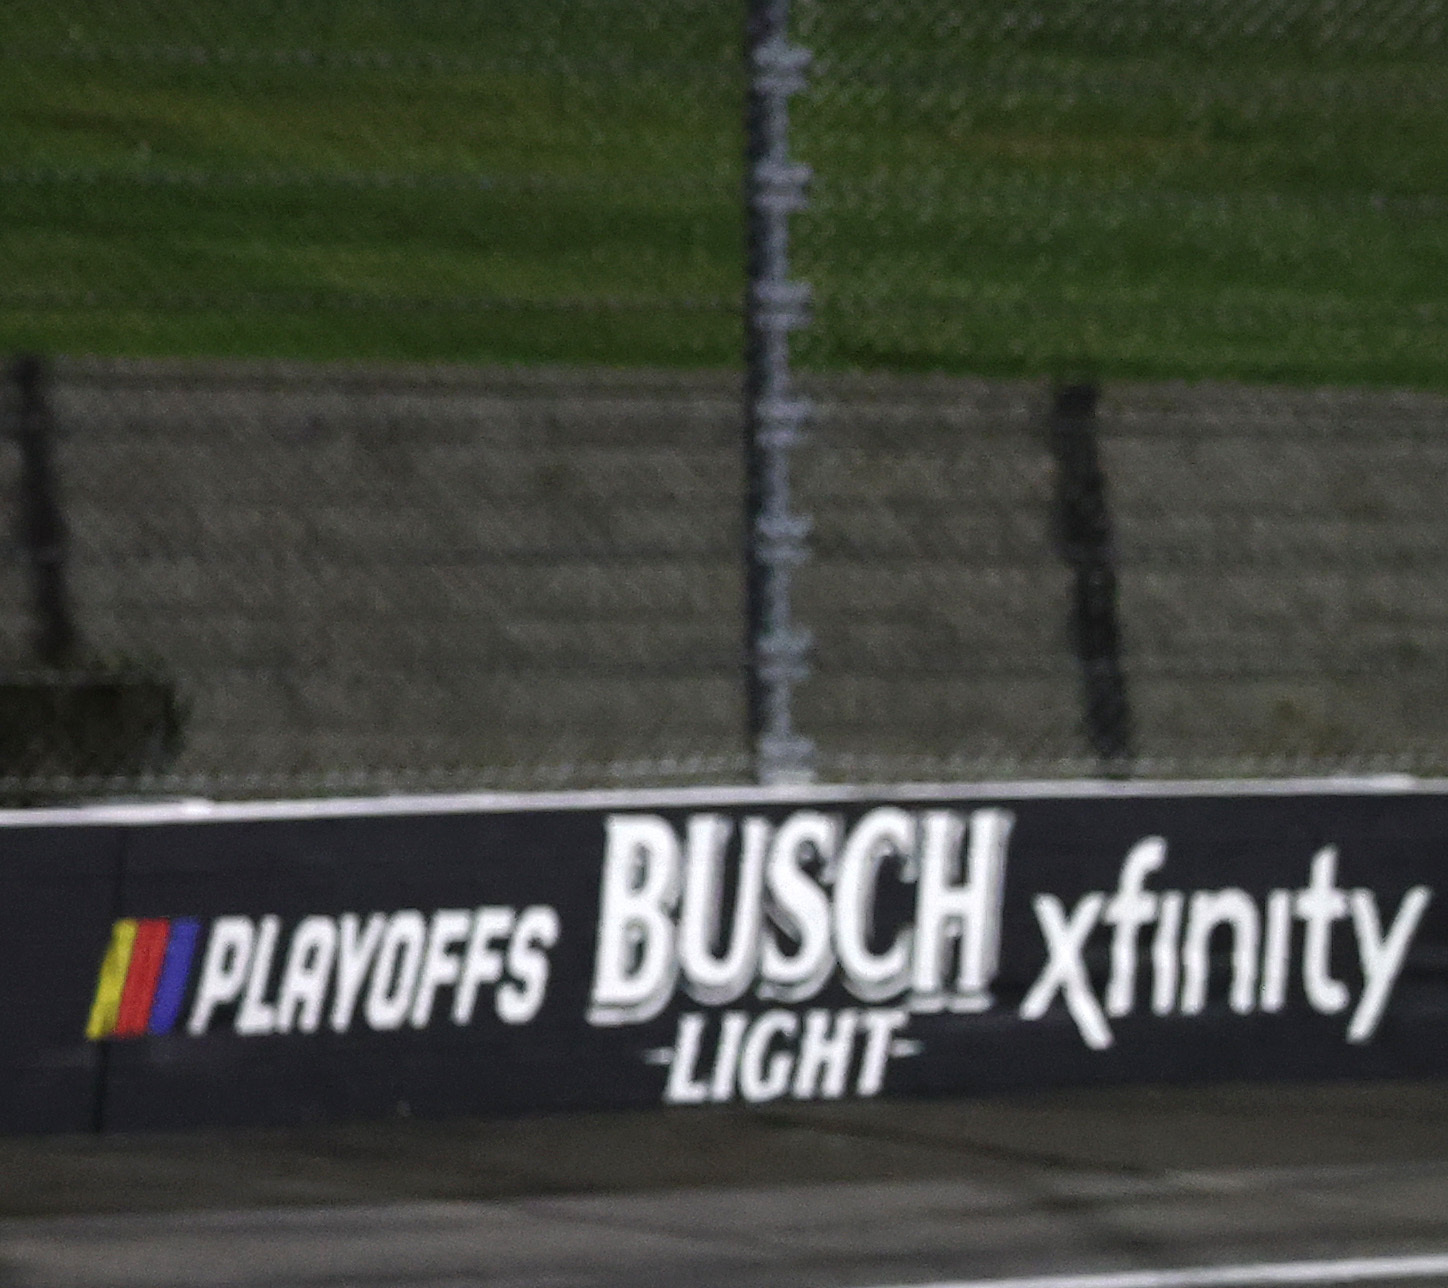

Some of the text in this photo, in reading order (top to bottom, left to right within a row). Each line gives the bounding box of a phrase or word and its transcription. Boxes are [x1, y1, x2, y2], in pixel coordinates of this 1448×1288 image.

[188, 906, 560, 1034] PLAYOFFS
[588, 806, 1014, 1024] BUSCH
[1020, 836, 1432, 1048] xfinity
[662, 1008, 908, 1104] LIGHT
